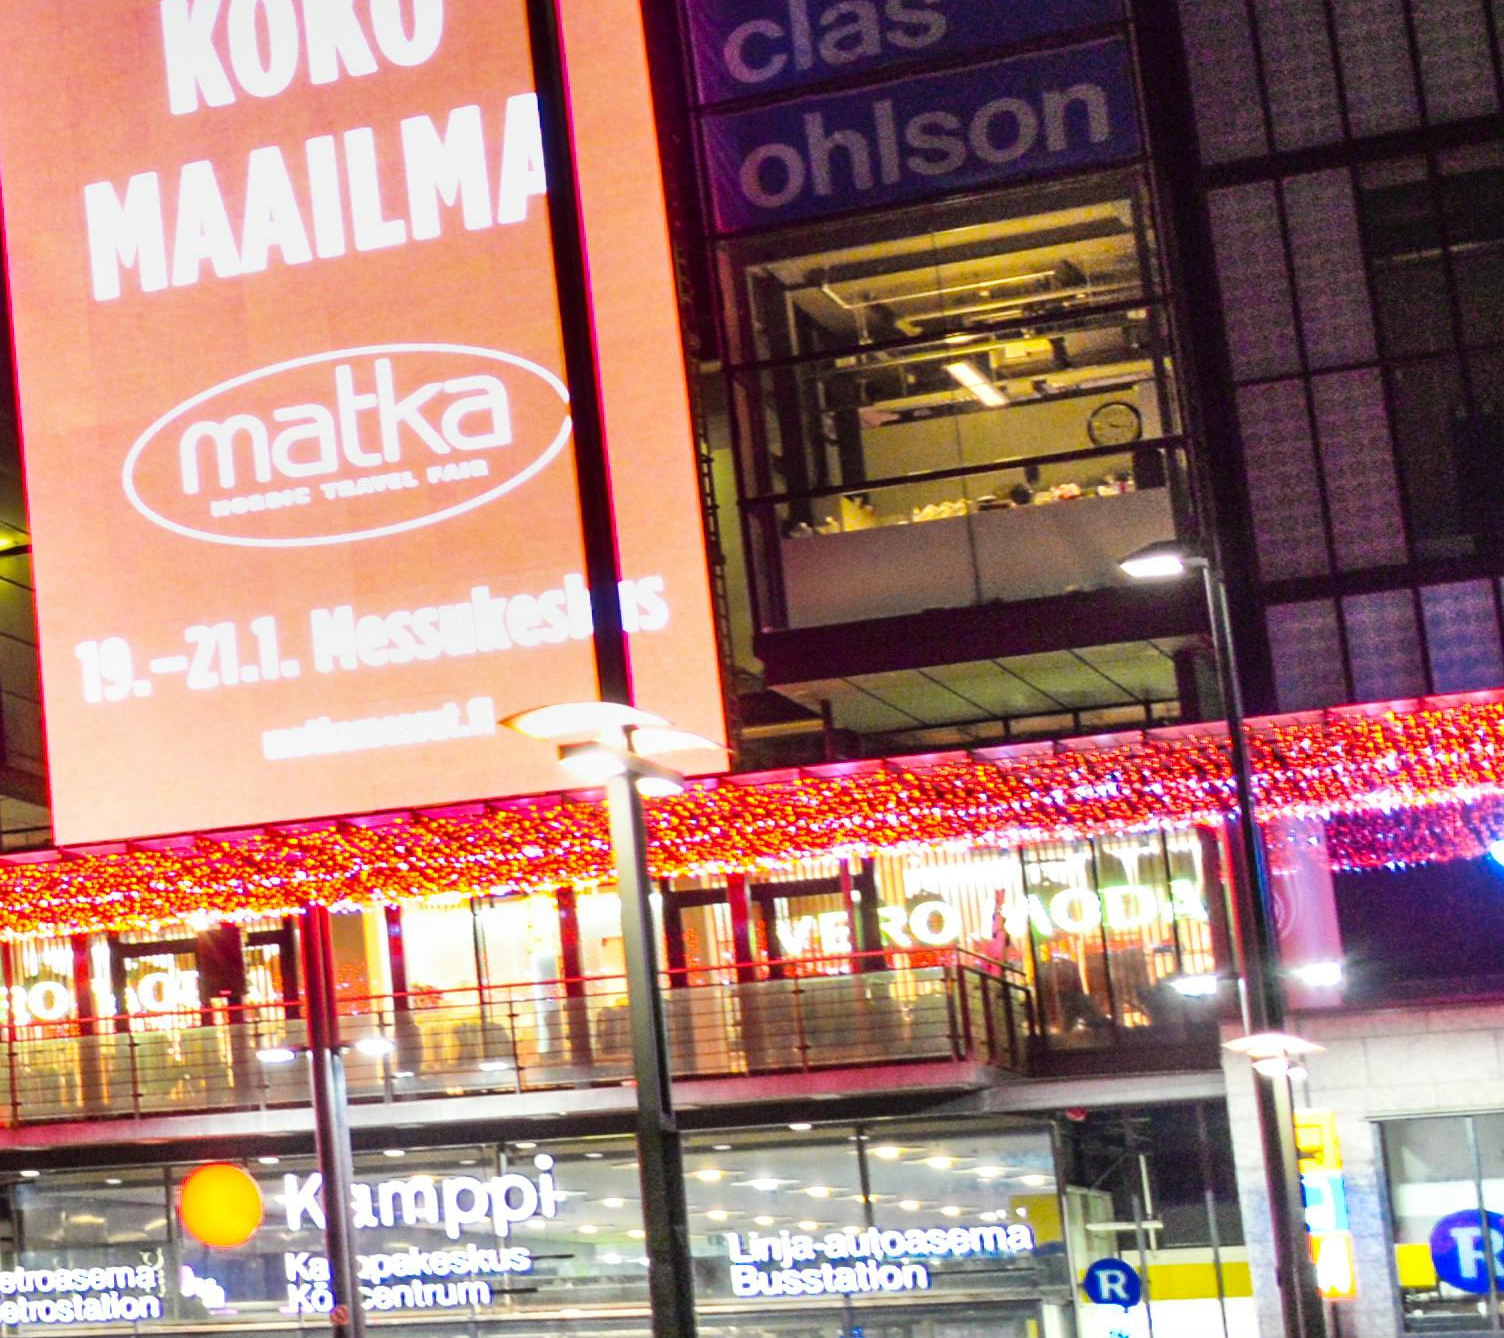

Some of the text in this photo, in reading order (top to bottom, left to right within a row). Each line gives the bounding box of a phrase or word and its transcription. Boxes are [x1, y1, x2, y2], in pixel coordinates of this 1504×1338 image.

[738, 82, 1111, 209] ohlson
[178, 357, 513, 495] matka
[319, 470, 419, 500] TRAVEL
[425, 459, 489, 484] FAIR
[728, 1222, 1035, 1268] Linja-autoasema
[730, 1259, 929, 1298] Busstation
[1094, 1269, 1130, 1301] R
